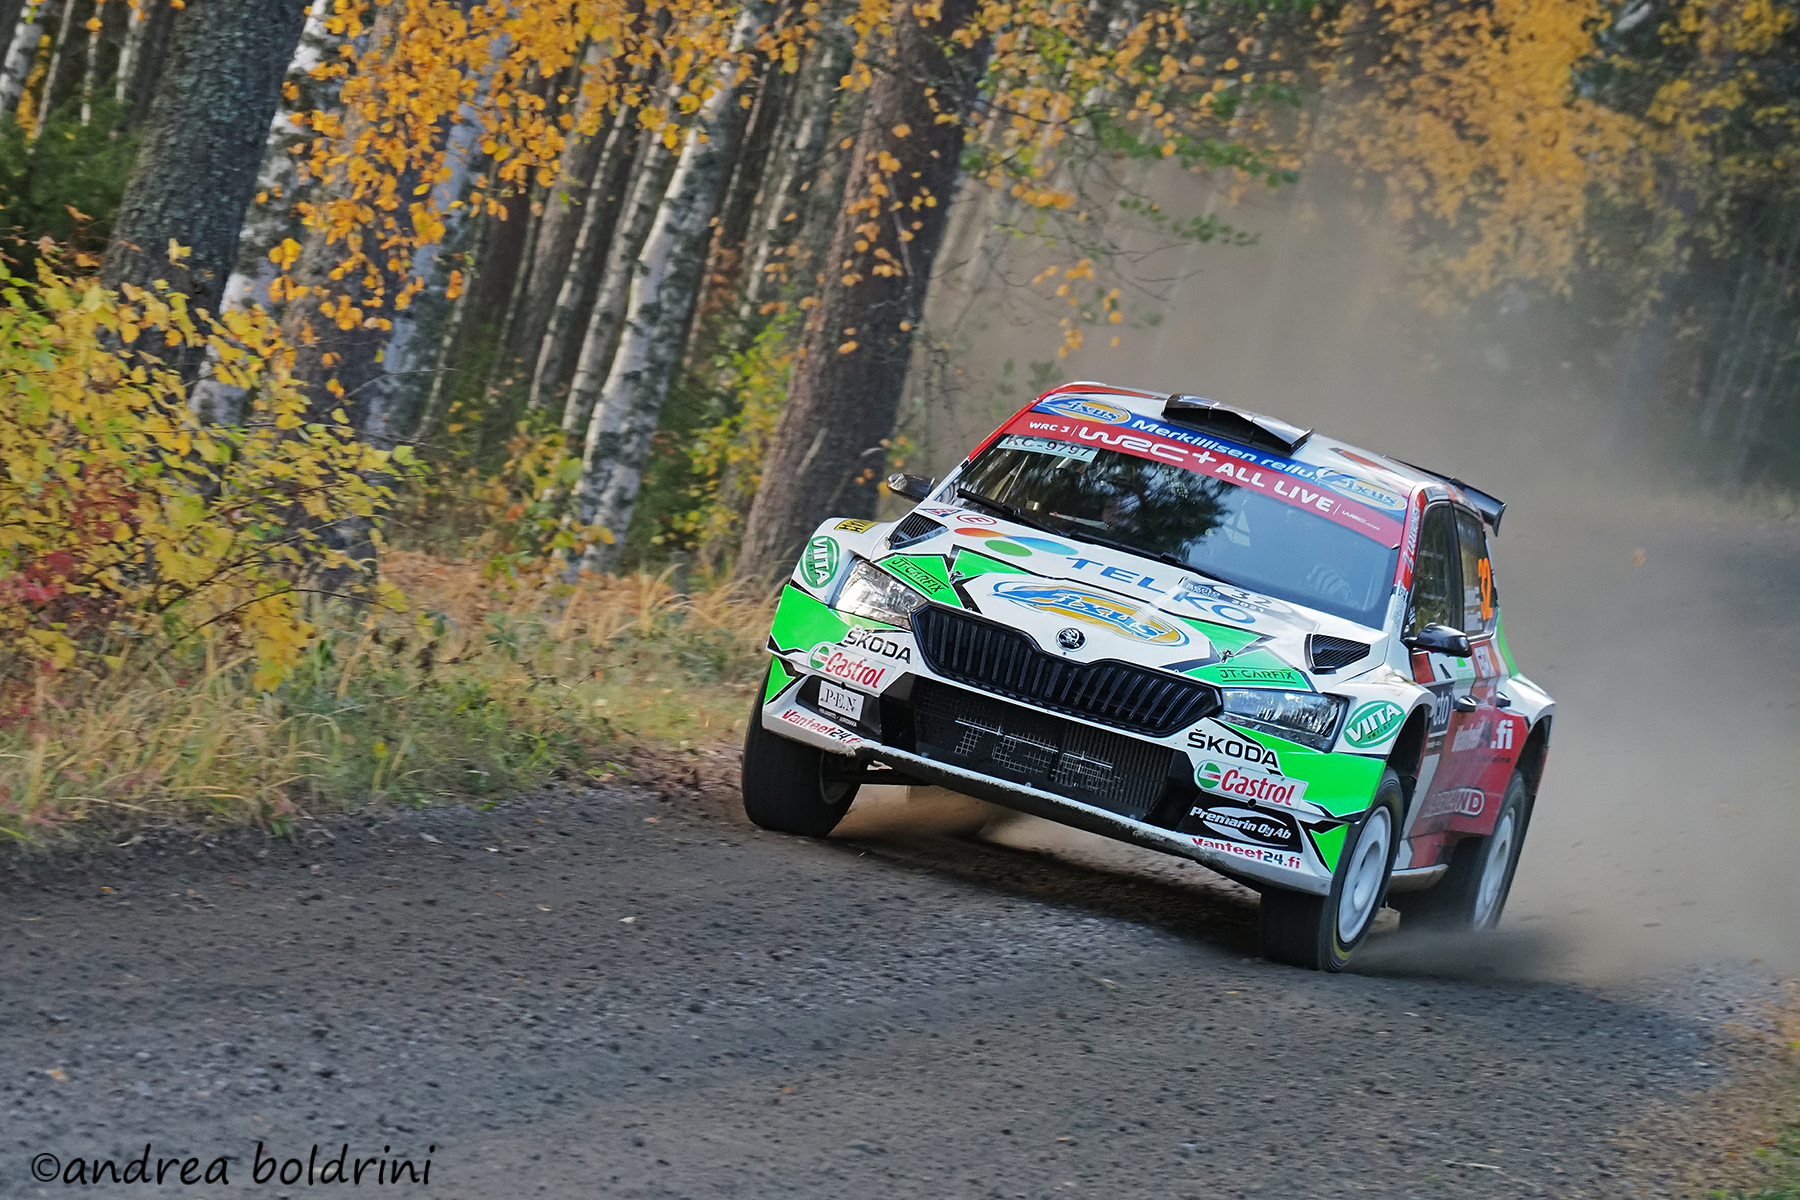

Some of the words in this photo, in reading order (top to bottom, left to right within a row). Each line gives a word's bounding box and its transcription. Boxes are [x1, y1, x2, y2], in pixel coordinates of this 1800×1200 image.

[1029, 421, 1058, 431] WRC
[1060, 425, 1070, 433] 3
[1131, 419, 1258, 462] Merkillisen
[1214, 462, 1265, 488] ALL
[1274, 480, 1336, 512] LIVE
[812, 537, 831, 586] VIITA
[1066, 557, 1256, 624] TELKO
[1231, 589, 1272, 608] 32
[1231, 599, 1264, 613] 2021
[844, 627, 911, 664] ŠKODA
[825, 652, 886, 688] Castrol
[1345, 704, 1403, 742] VIITA
[1187, 729, 1279, 768] ŠKODA
[1221, 769, 1296, 806] Castrol
[1189, 806, 1257, 832] Premarin
[1257, 823, 1275, 838] Oy
[1273, 828, 1292, 840] Ab
